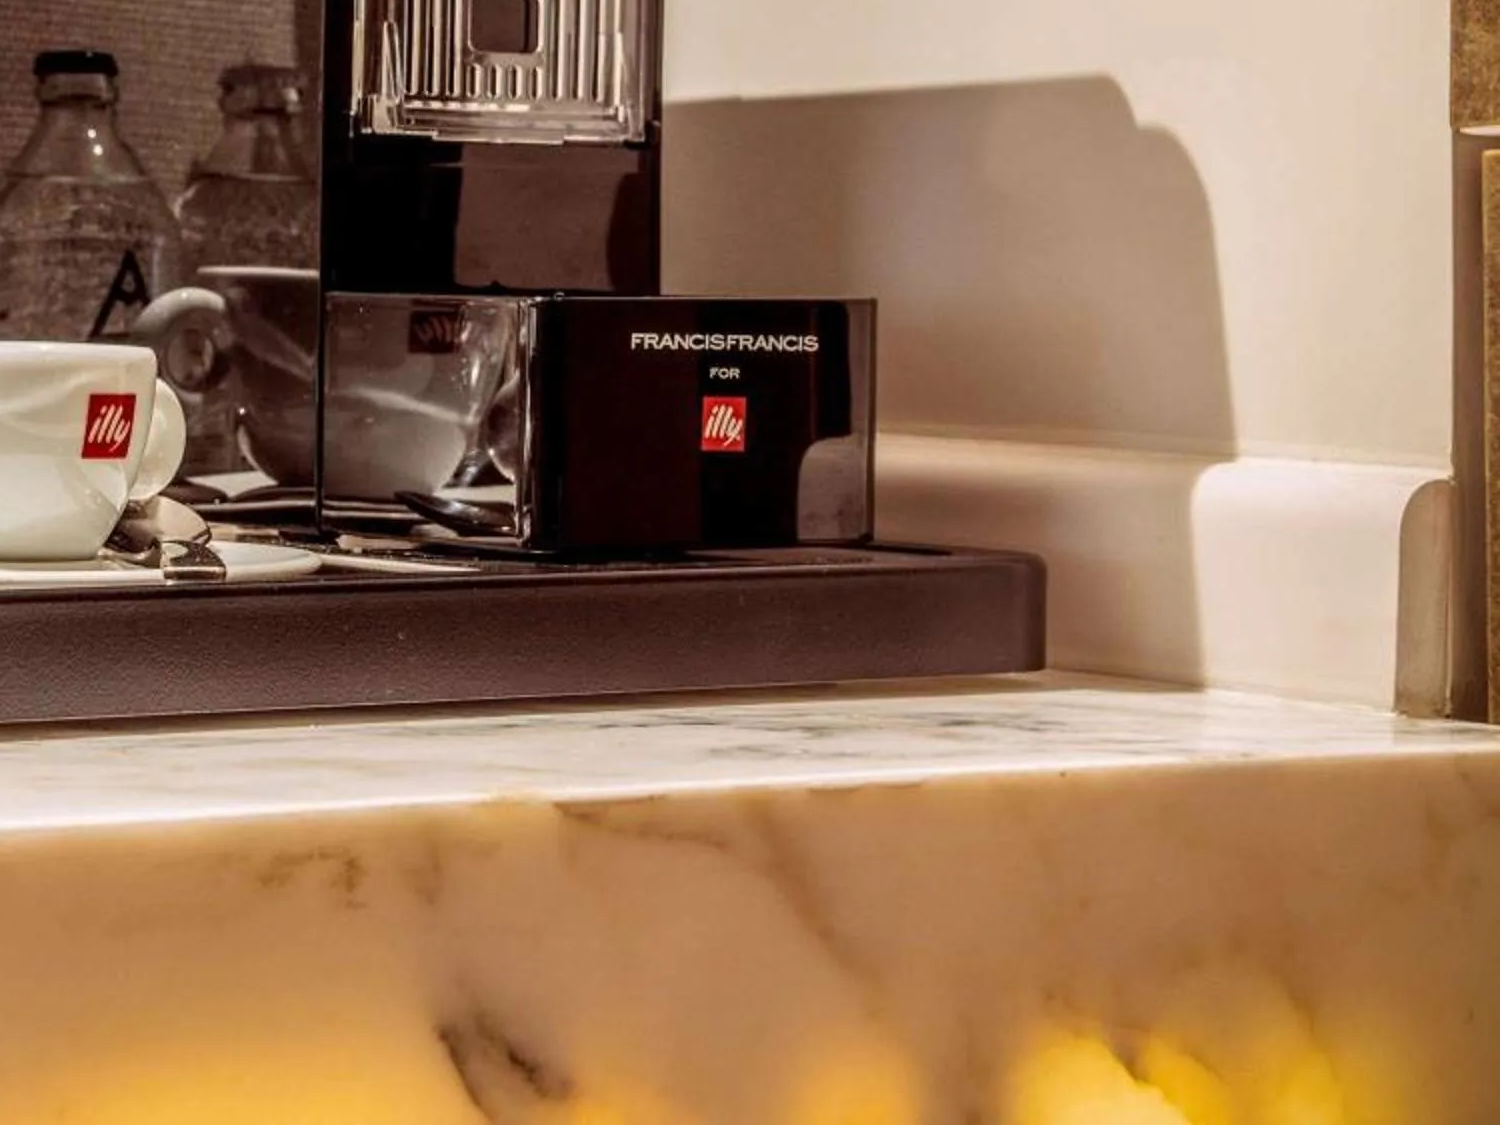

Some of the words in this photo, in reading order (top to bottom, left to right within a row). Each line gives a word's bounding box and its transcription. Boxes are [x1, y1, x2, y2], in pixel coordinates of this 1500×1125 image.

[630, 332, 820, 352] FRANCISFRANCIS
[709, 366, 741, 380] FOR
[87, 403, 131, 453] illy
[704, 404, 744, 448] illy
